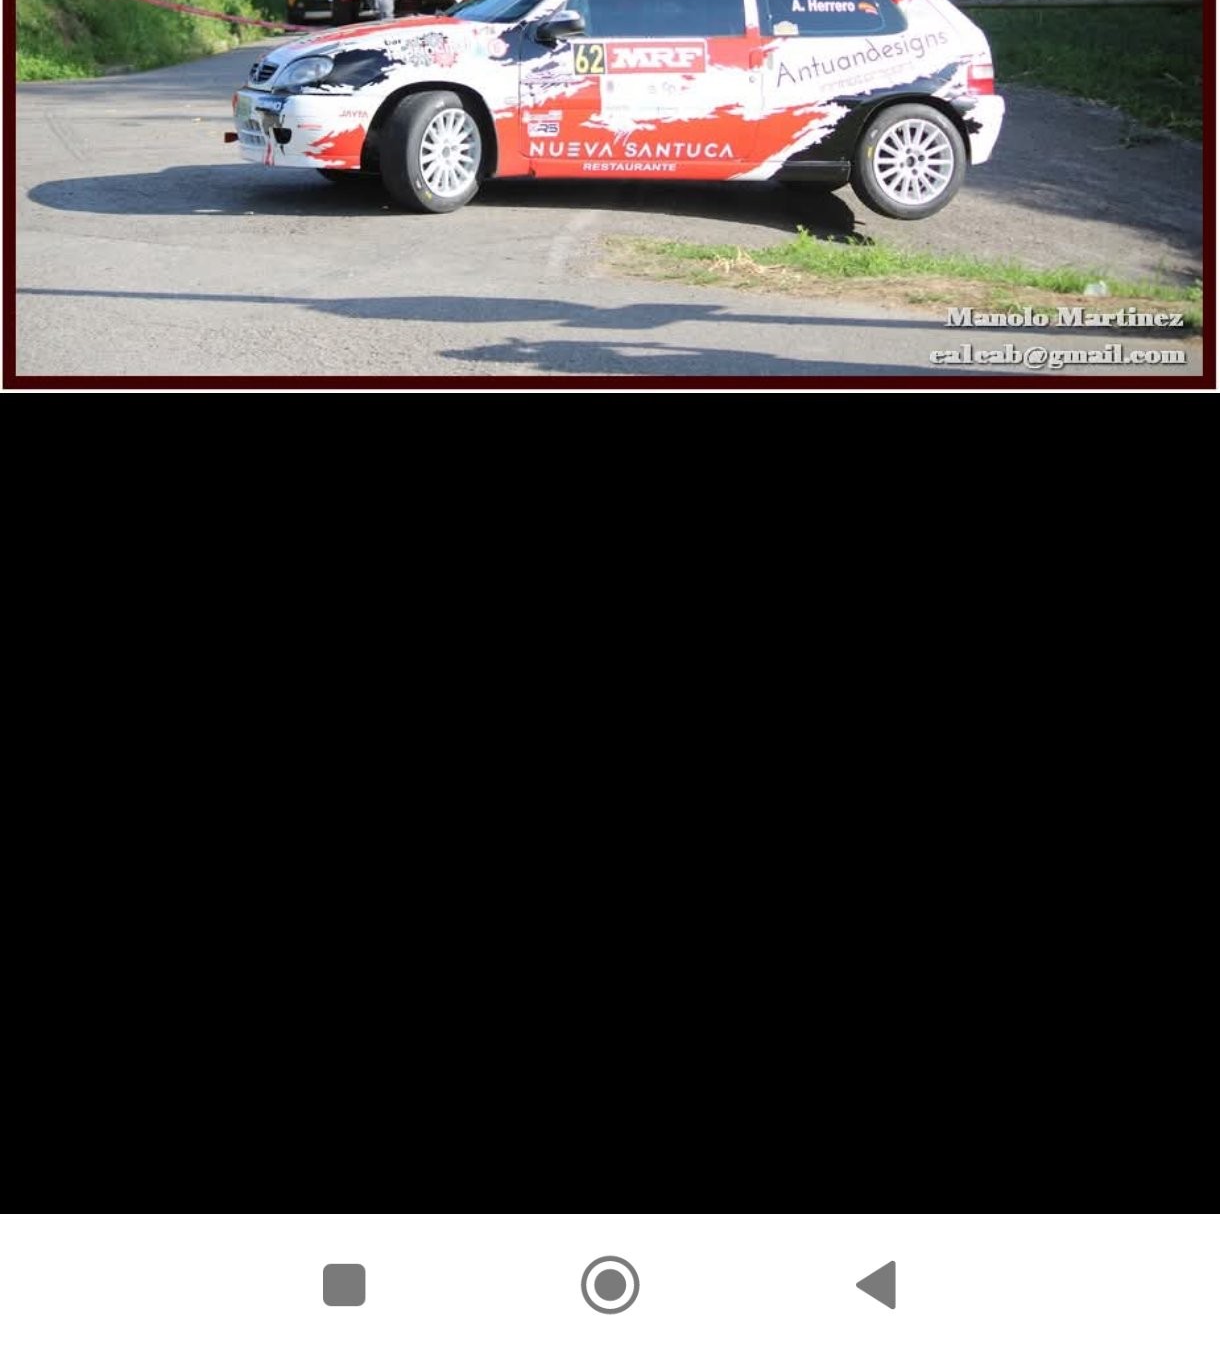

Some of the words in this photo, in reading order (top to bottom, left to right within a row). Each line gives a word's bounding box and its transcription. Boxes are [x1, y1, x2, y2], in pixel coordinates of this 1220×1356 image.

[575, 44, 604, 73] 62
[611, 46, 703, 68] MRF
[776, 31, 949, 88] Antuandesigns
[529, 142, 613, 158] NUEVA
[624, 142, 734, 158] SANTUCA
[582, 162, 677, 172] RESTAURANTE
